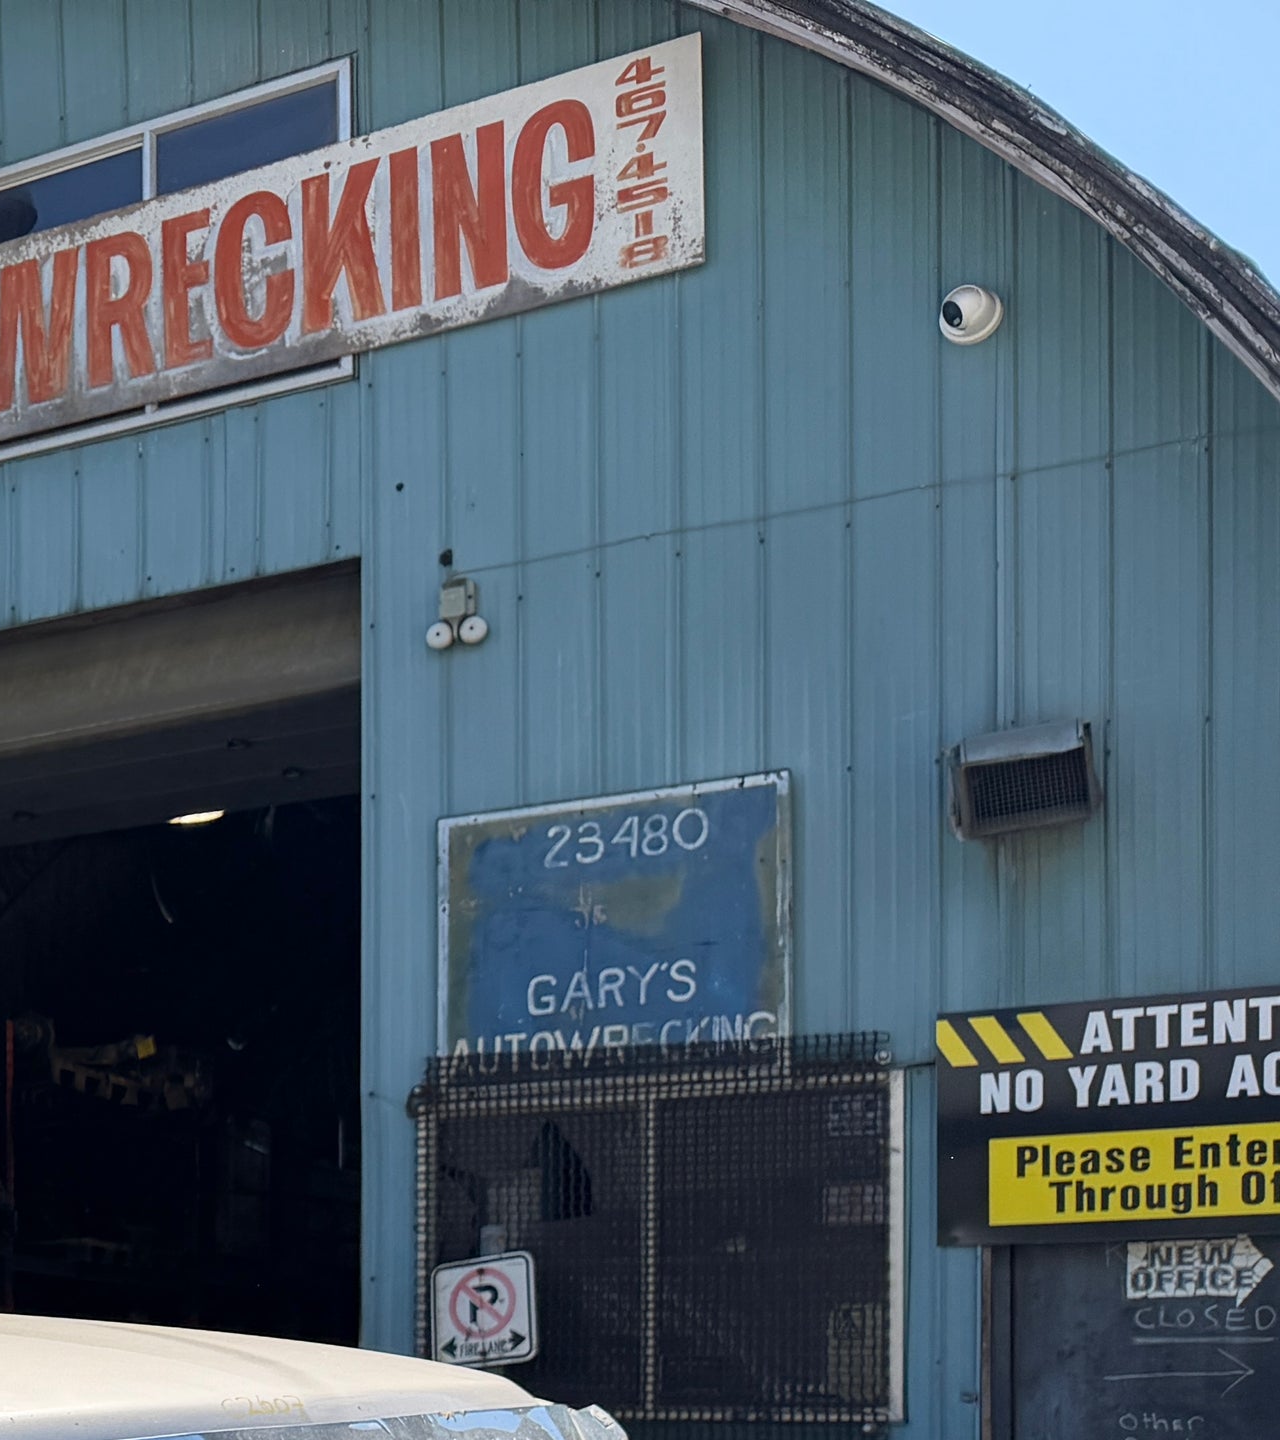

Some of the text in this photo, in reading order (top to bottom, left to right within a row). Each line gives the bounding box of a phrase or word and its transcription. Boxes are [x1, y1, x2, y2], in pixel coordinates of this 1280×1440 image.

[543, 807, 710, 868] 23480
[527, 959, 699, 1016] GARY'S
[1080, 995, 1280, 1055] ATTENT
[980, 1069, 1044, 1115] NO
[1068, 1058, 1200, 1108] YARD
[1016, 1144, 1151, 1179] Please
[1048, 1173, 1218, 1214] Through
[1148, 1244, 1234, 1267] NEW
[1130, 1266, 1257, 1293] OFFICE
[1134, 1303, 1277, 1331] CLOSED
